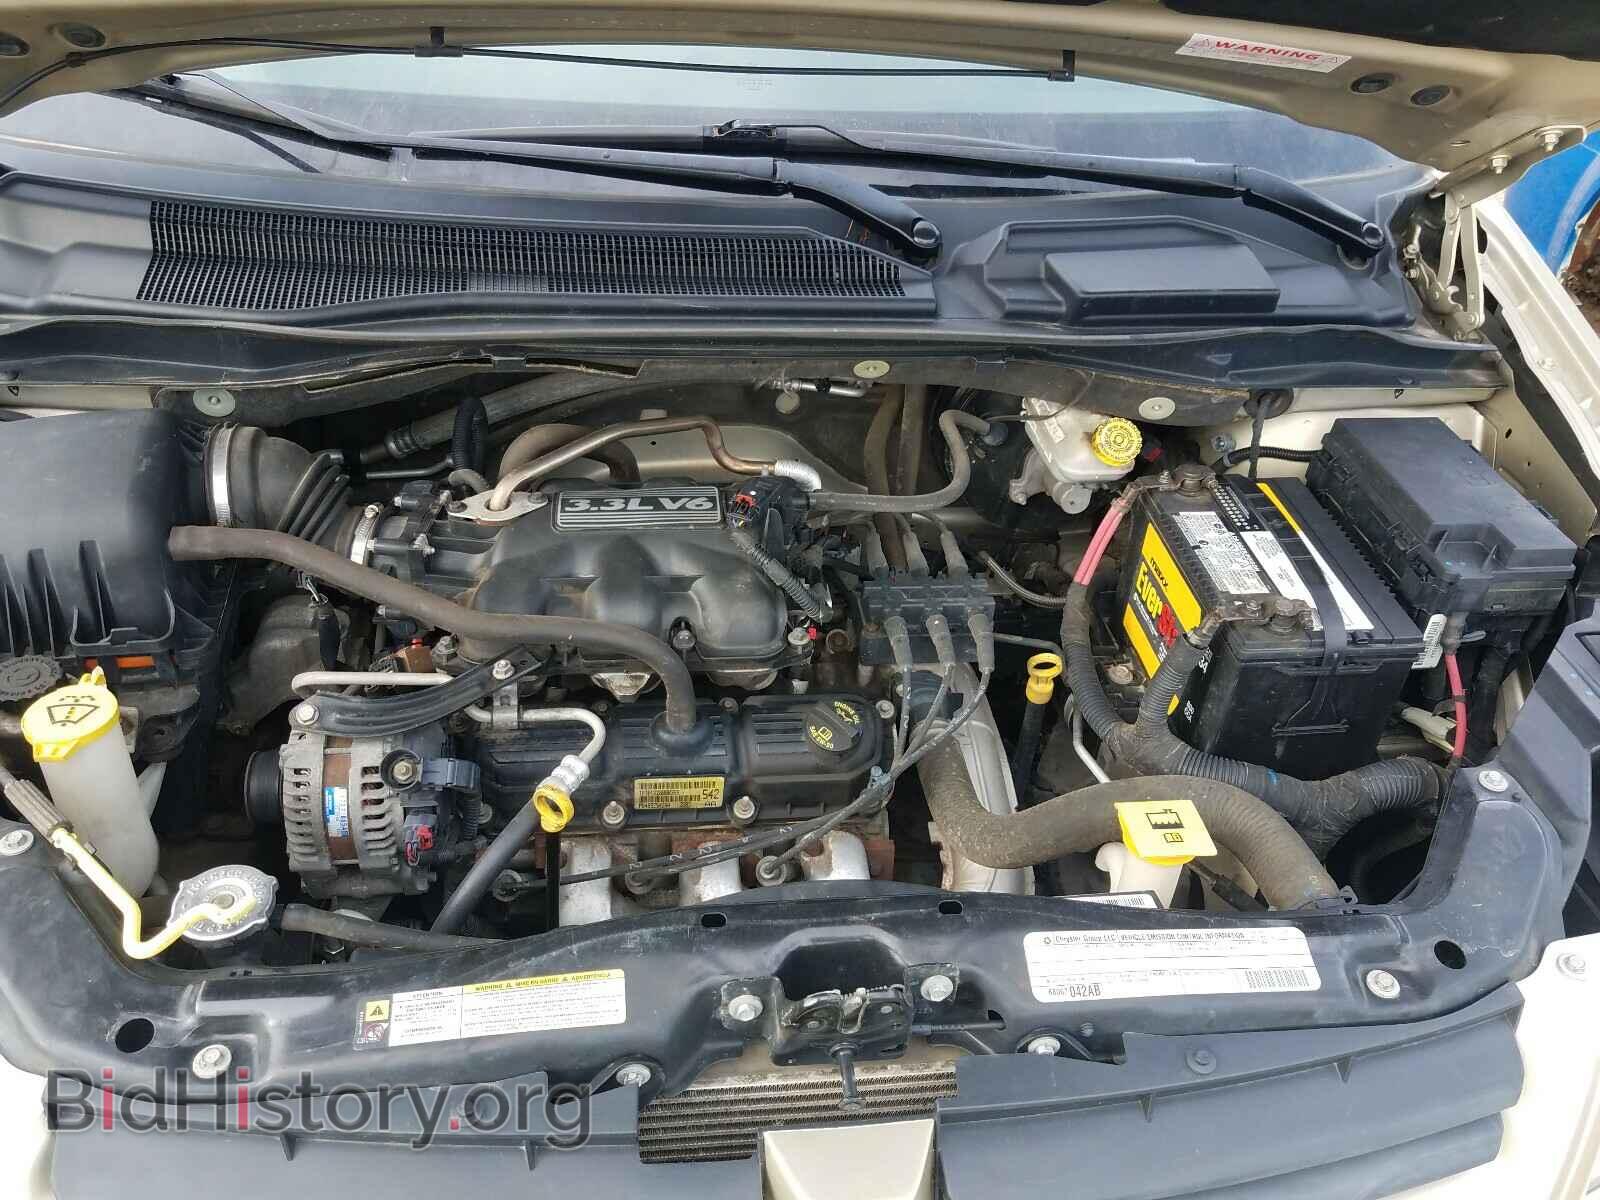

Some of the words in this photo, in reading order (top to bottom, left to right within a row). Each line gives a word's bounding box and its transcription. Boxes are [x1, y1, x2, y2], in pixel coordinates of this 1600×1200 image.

[1215, 40, 1322, 61] WARNING
[564, 498, 654, 512] 3.3L
[658, 496, 714, 510] V6
[702, 788, 720, 800] 542
[1069, 984, 1101, 998] 042AB
